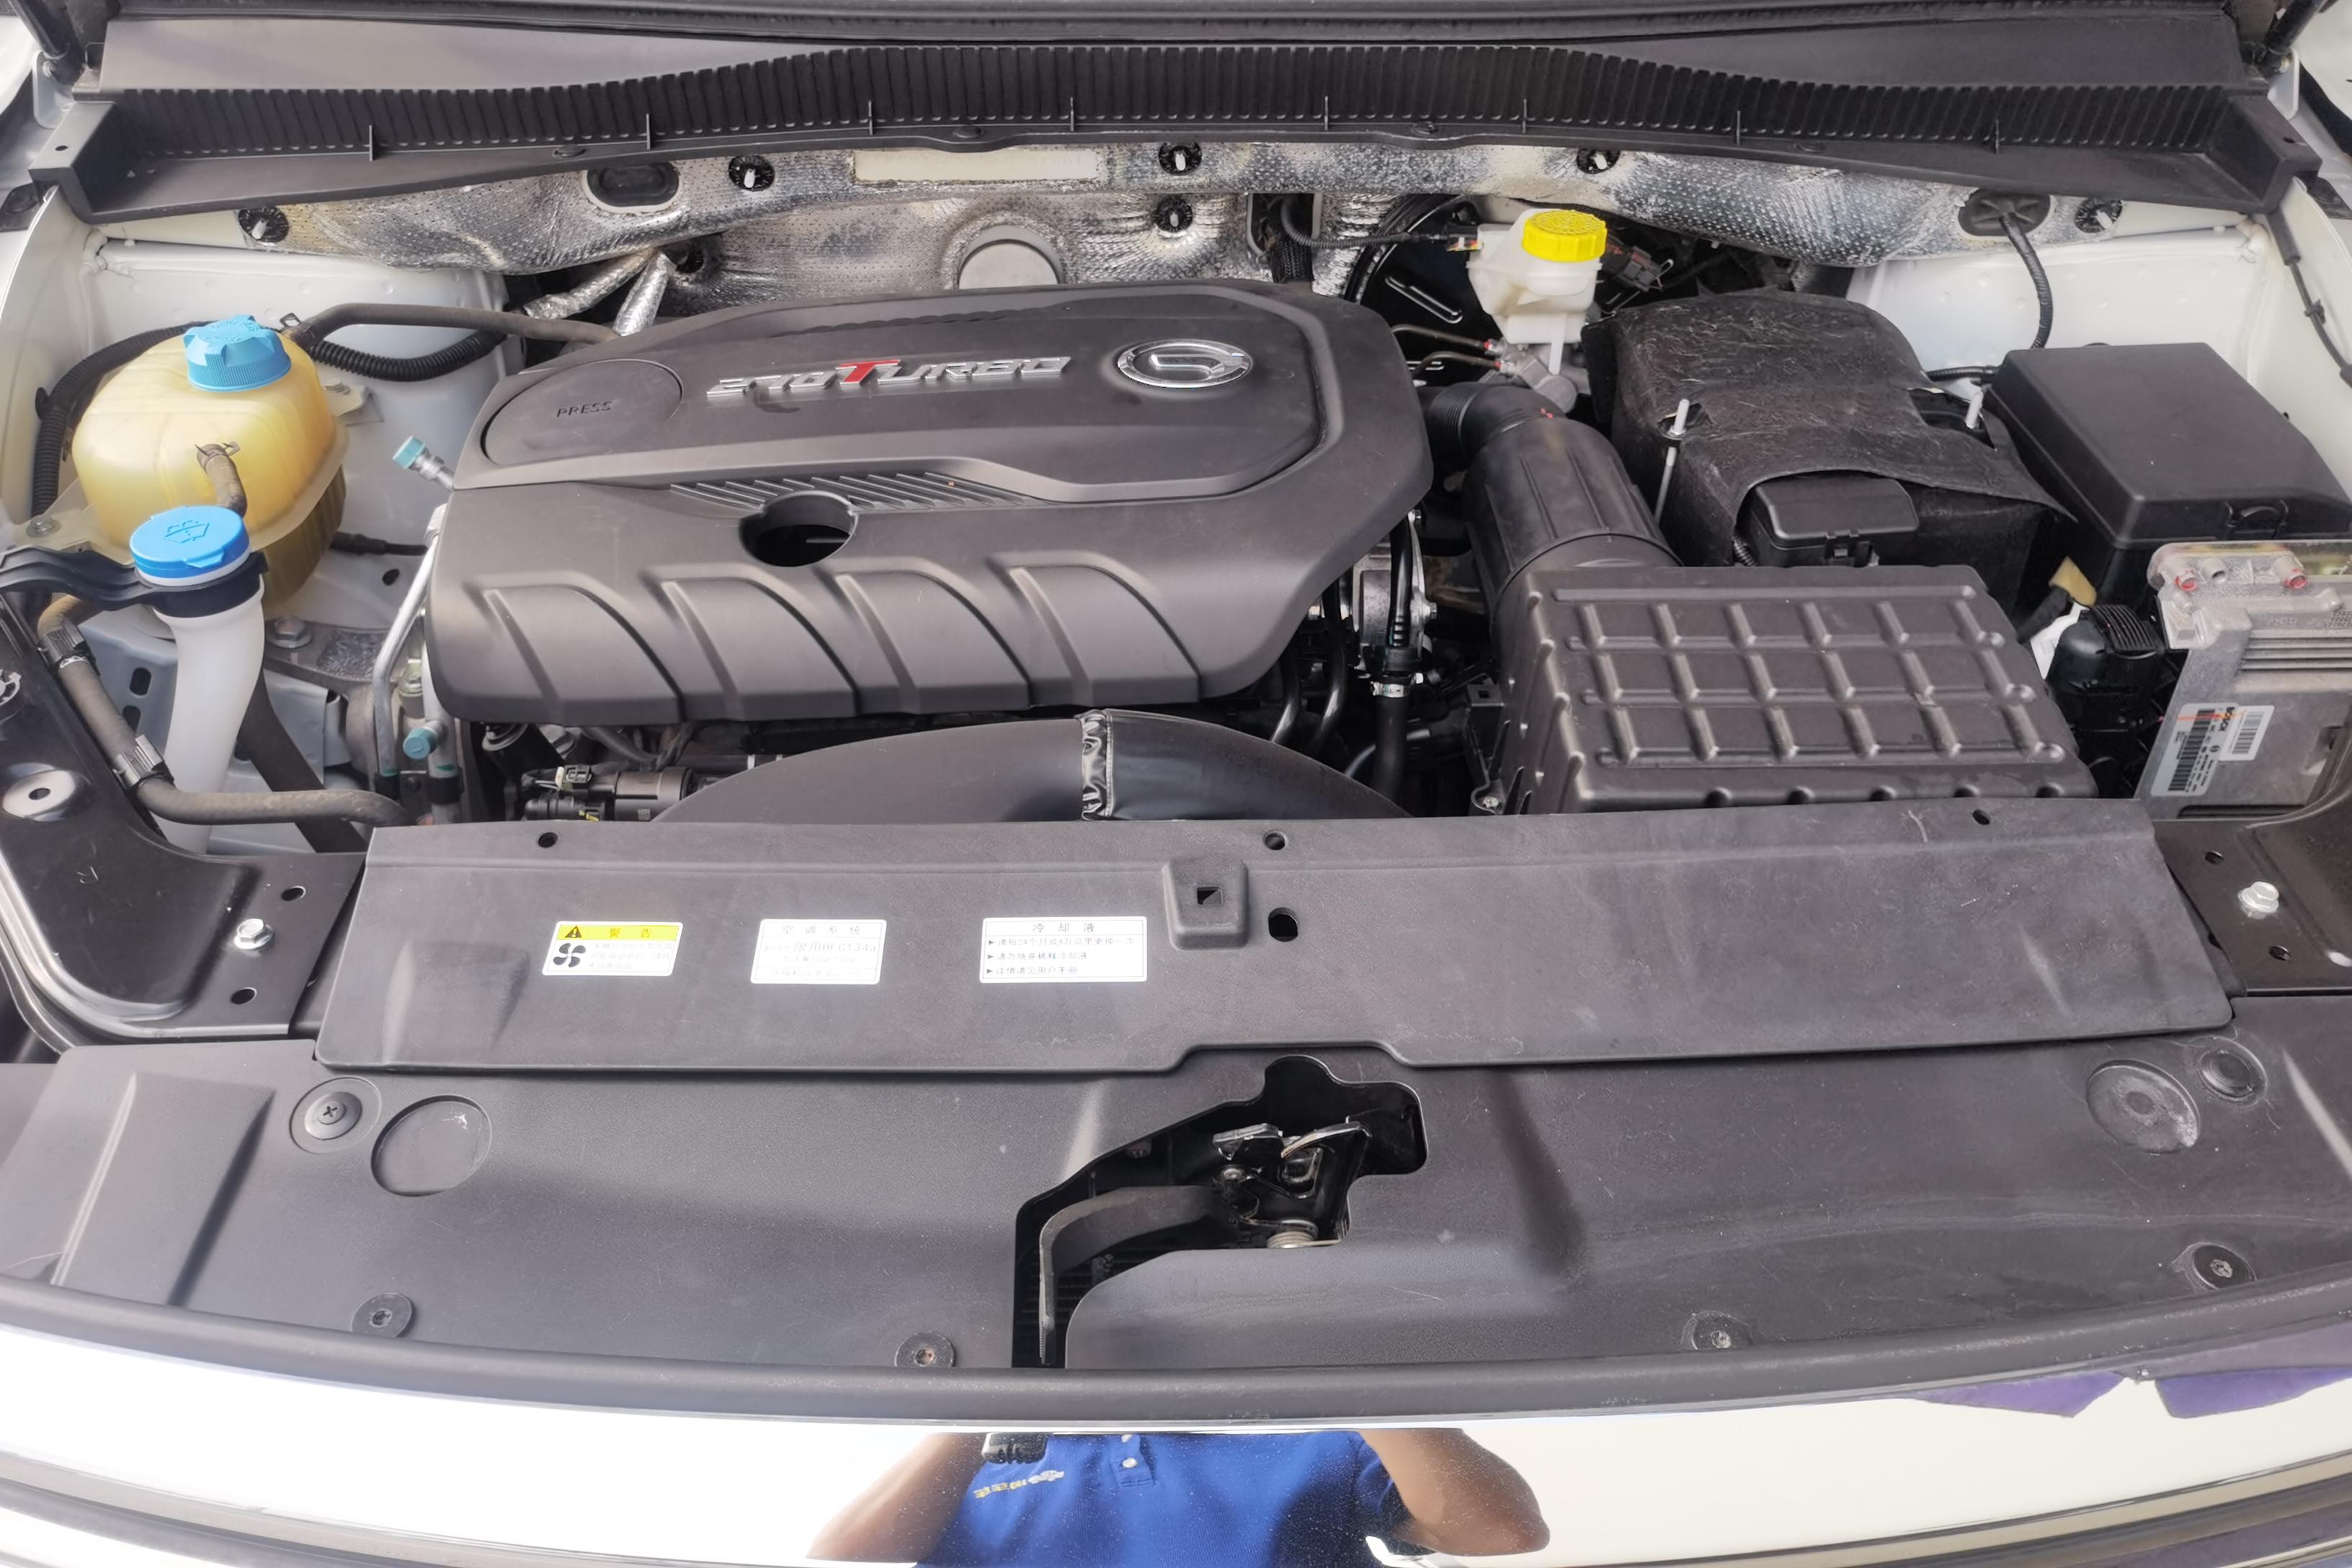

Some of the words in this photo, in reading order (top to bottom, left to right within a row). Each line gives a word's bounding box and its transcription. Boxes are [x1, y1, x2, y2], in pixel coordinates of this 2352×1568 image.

[556, 401, 613, 418] PRESS
[609, 927, 653, 939] 警告
[783, 925, 861, 935] 空调系统
[1033, 922, 1095, 933] 冷却液
